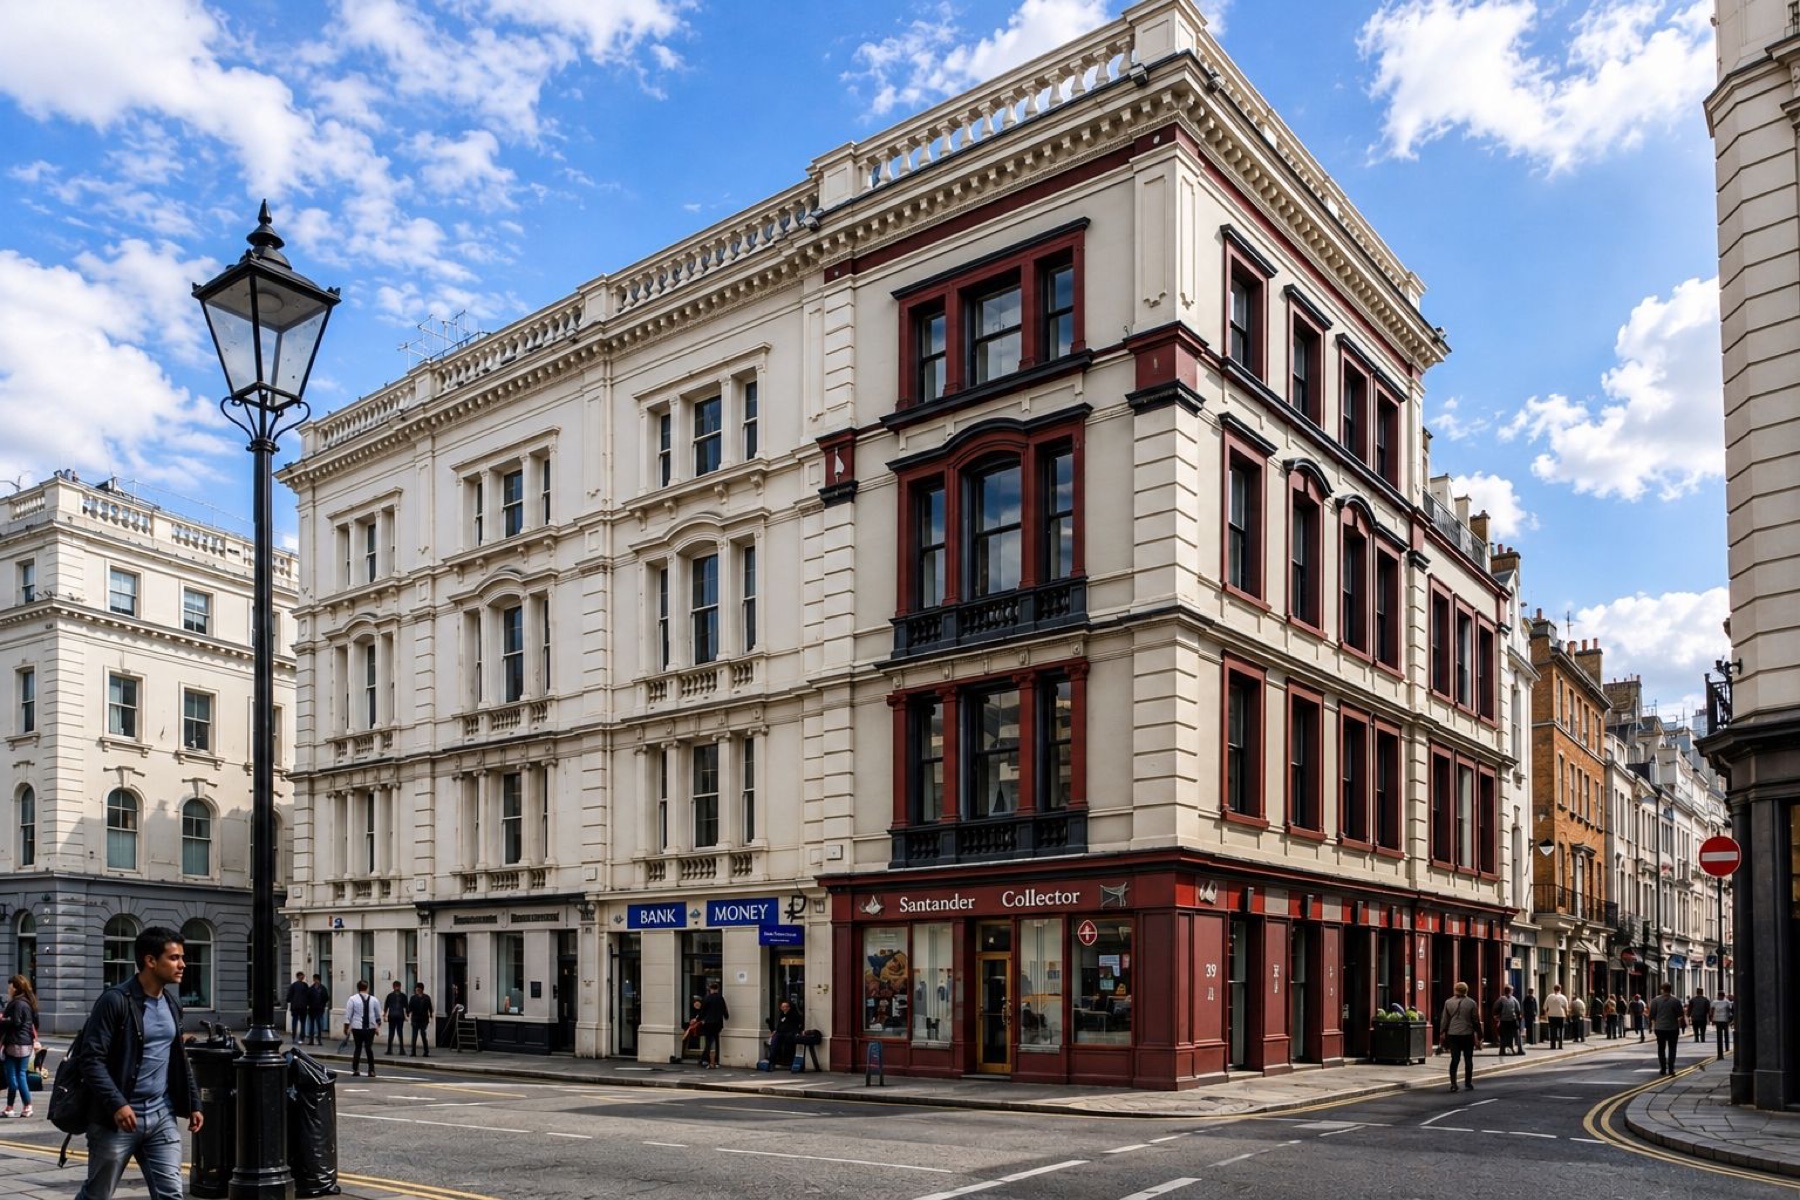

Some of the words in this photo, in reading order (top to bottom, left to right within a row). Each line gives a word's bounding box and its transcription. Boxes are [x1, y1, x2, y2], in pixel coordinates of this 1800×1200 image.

[899, 893, 975, 913] Santander
[1002, 889, 1080, 908] Collector
[640, 908, 676, 924] BANK
[714, 904, 768, 921] MONEY
[1206, 963, 1217, 977] 39
